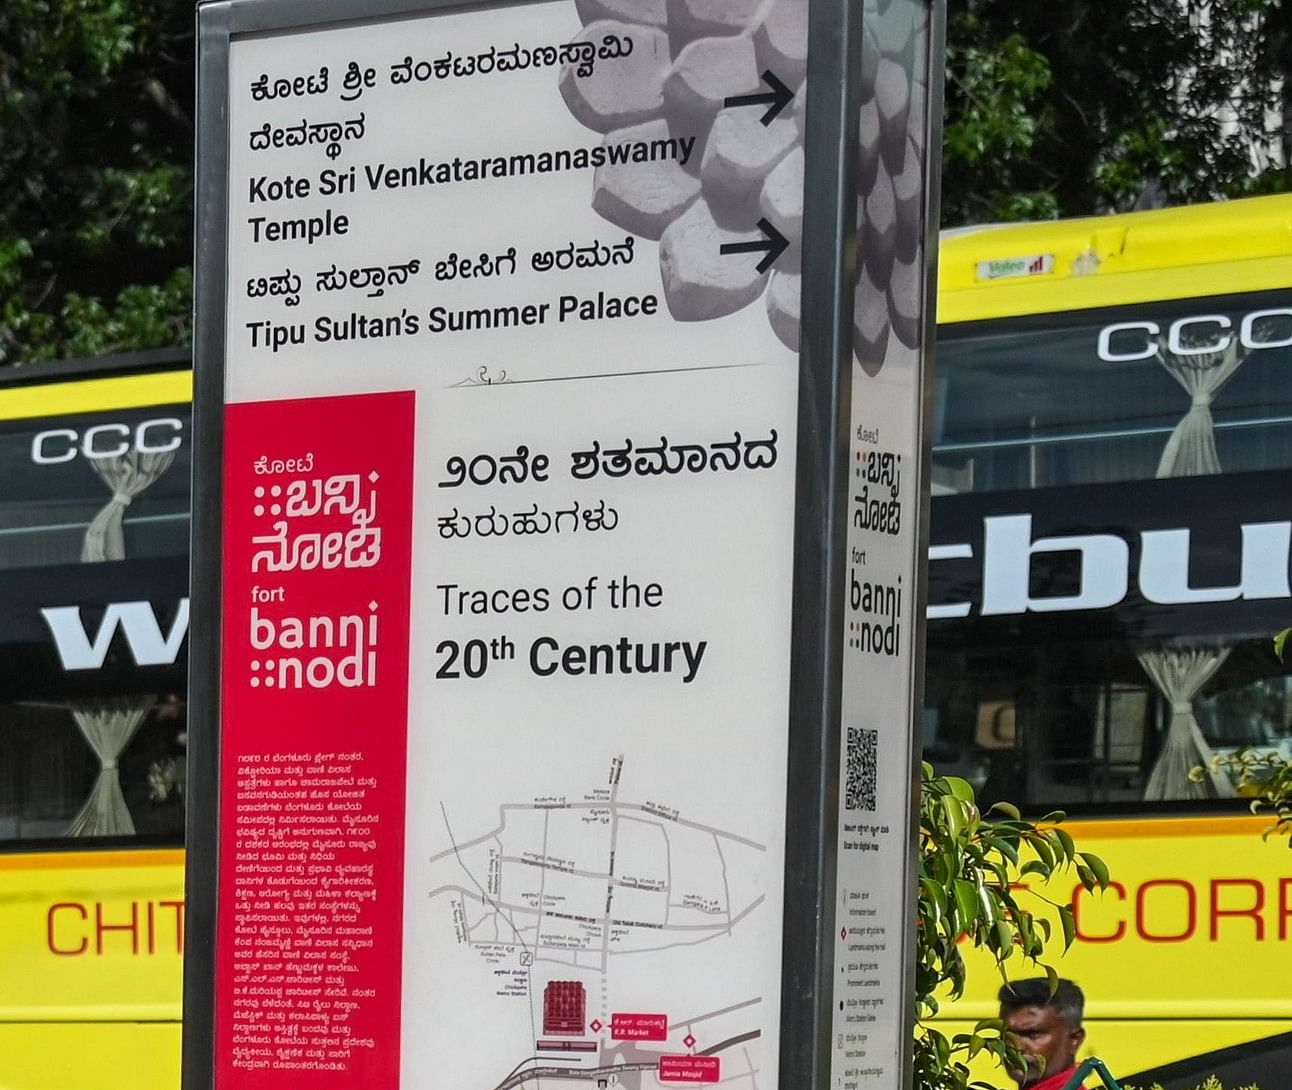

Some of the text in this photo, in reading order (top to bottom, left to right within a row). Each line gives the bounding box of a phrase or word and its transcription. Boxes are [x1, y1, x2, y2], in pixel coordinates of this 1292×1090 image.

[249, 135, 696, 203] Kote Sri Venkataramanaswamy
[247, 208, 348, 244] Temple
[245, 291, 657, 352] Tipu Sultan's Summer Palace
[32, 418, 183, 465] CCC
[851, 548, 865, 565] fort
[251, 585, 284, 602] fort
[436, 575, 662, 615] Traces of the
[850, 568, 902, 618] banni
[250, 600, 378, 650] banni
[860, 619, 899, 656] nodi
[278, 647, 376, 689] nodi
[435, 635, 707, 683] 20th Century
